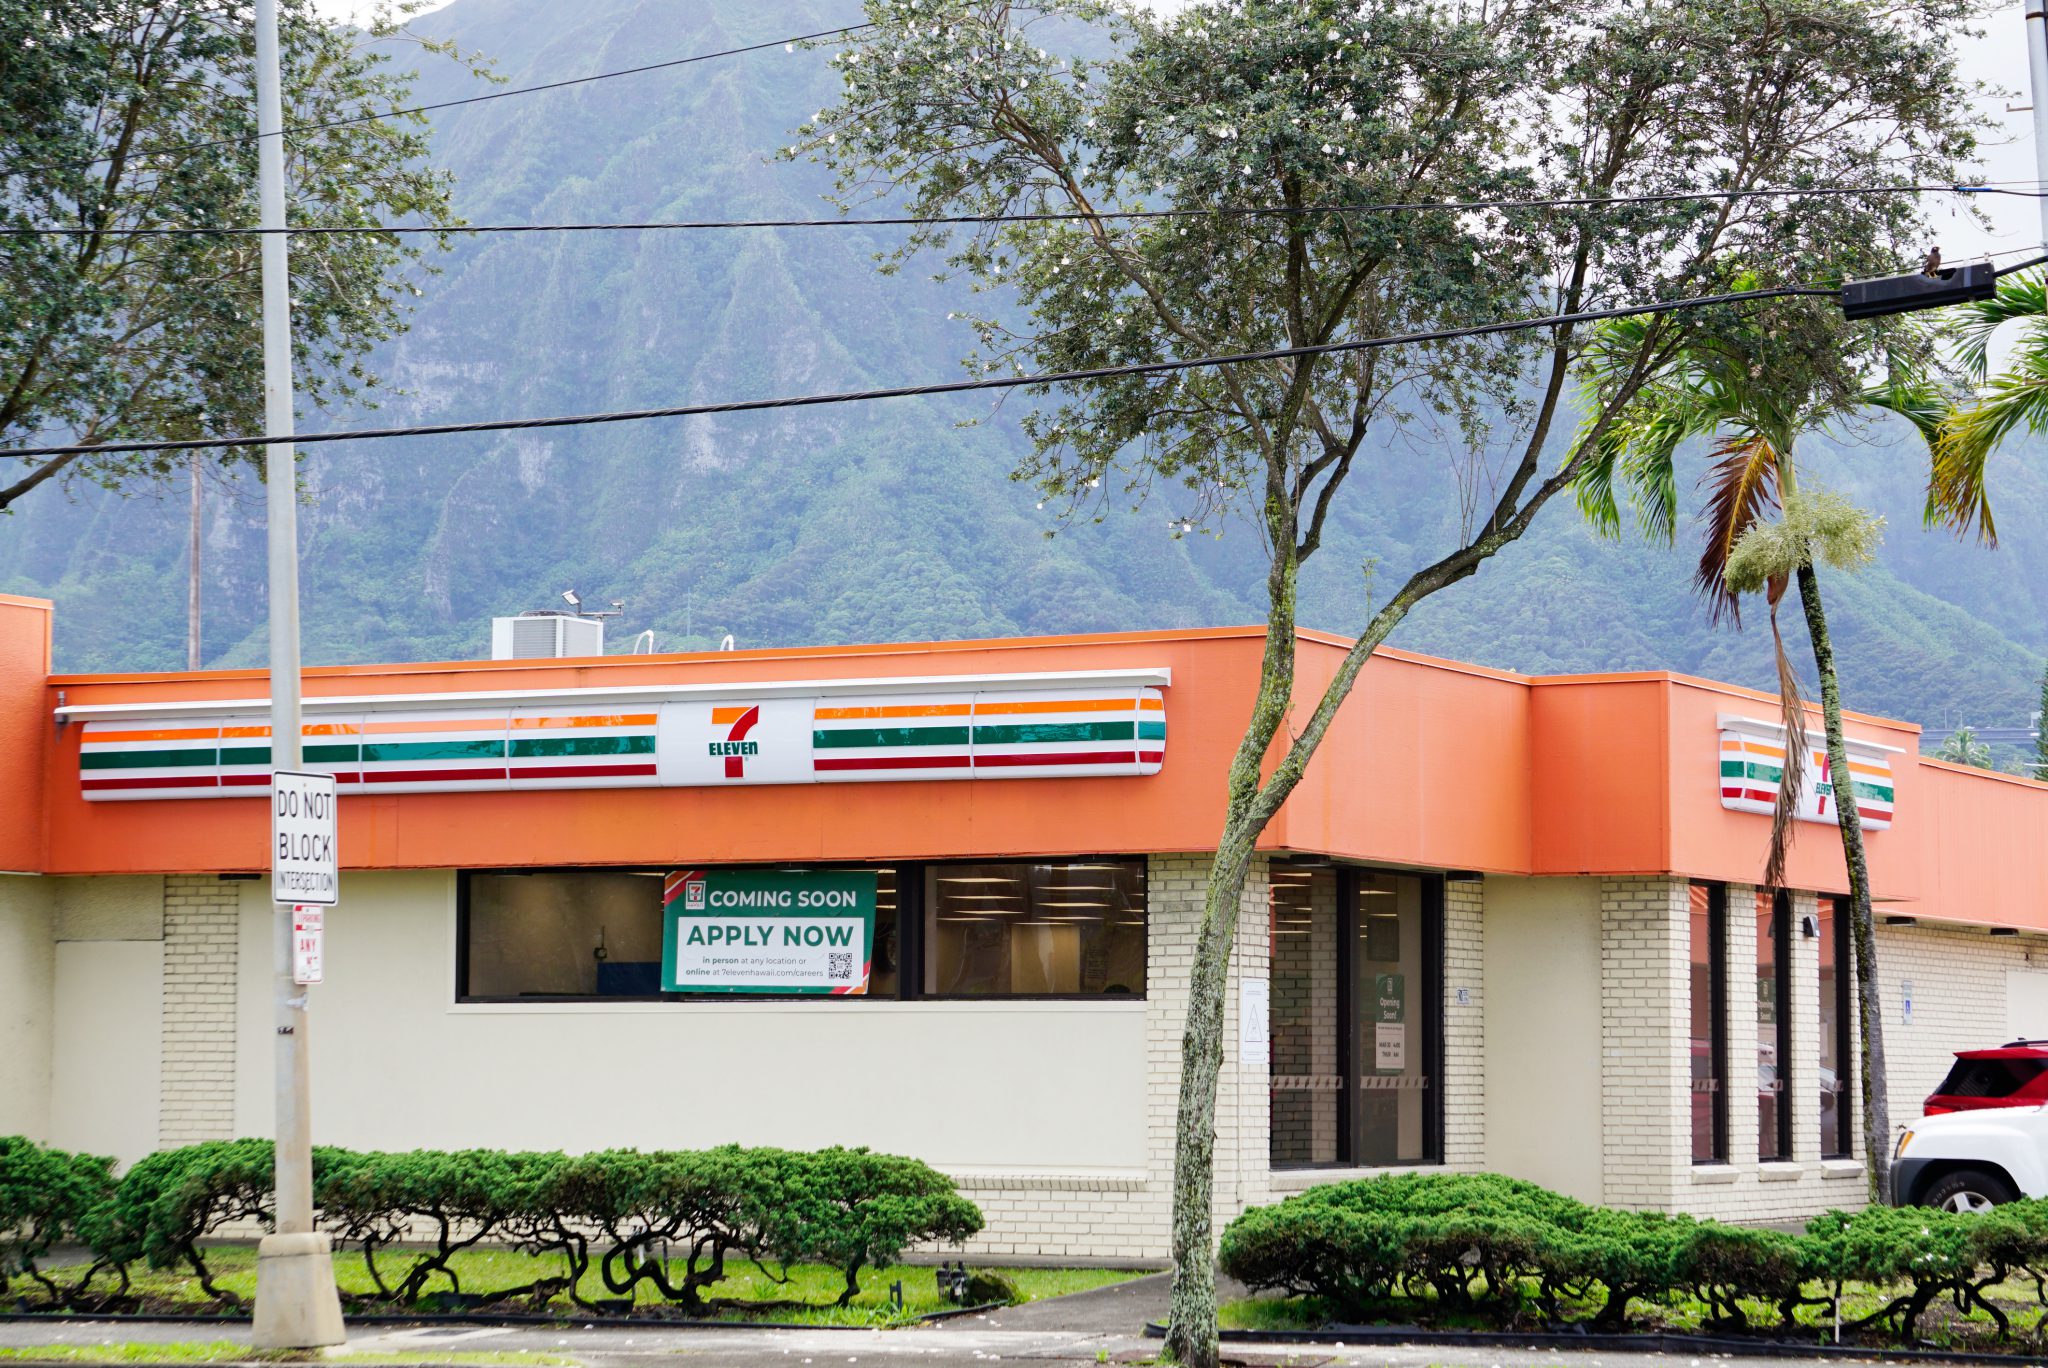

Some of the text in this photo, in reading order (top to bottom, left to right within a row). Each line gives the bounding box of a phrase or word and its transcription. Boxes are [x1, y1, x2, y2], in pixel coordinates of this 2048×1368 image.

[711, 704, 759, 777] 7
[278, 789, 331, 820] DO NOT
[279, 832, 332, 863] BLOCK
[709, 890, 857, 907] COMING SOON
[686, 925, 854, 947] APPLY NOW
[702, 956, 710, 964] in
[712, 957, 739, 965] person
[750, 958, 764, 966] any
[766, 957, 797, 965] location
[685, 968, 711, 976] online
[1379, 996, 1400, 1009] Opening
